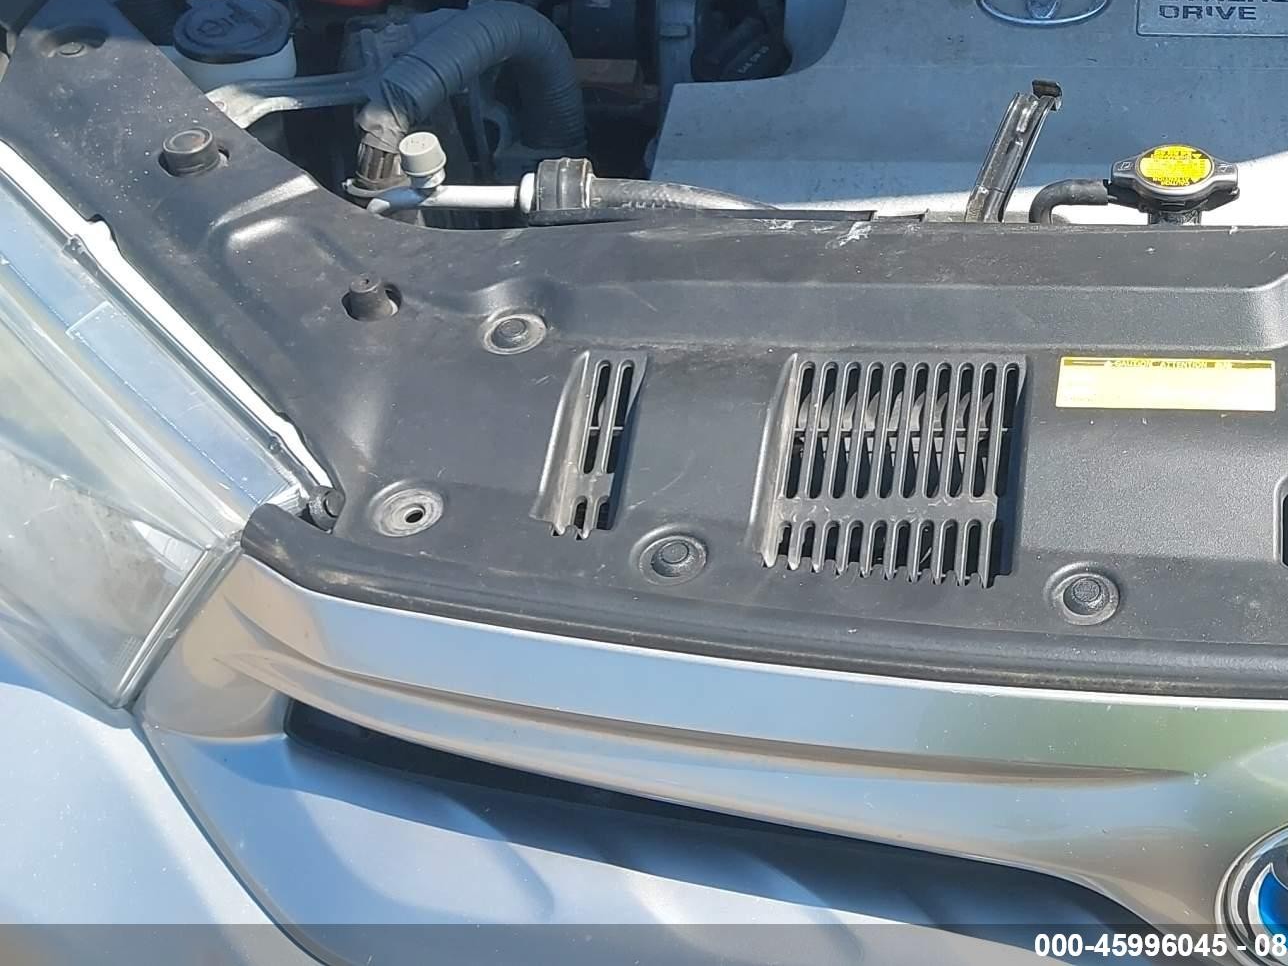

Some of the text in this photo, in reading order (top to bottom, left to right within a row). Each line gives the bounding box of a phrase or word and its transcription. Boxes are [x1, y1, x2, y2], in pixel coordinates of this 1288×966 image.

[1159, 4, 1257, 20] DRIVE
[1114, 359, 1151, 368] CAUTION
[1161, 361, 1208, 370] ATTENTION
